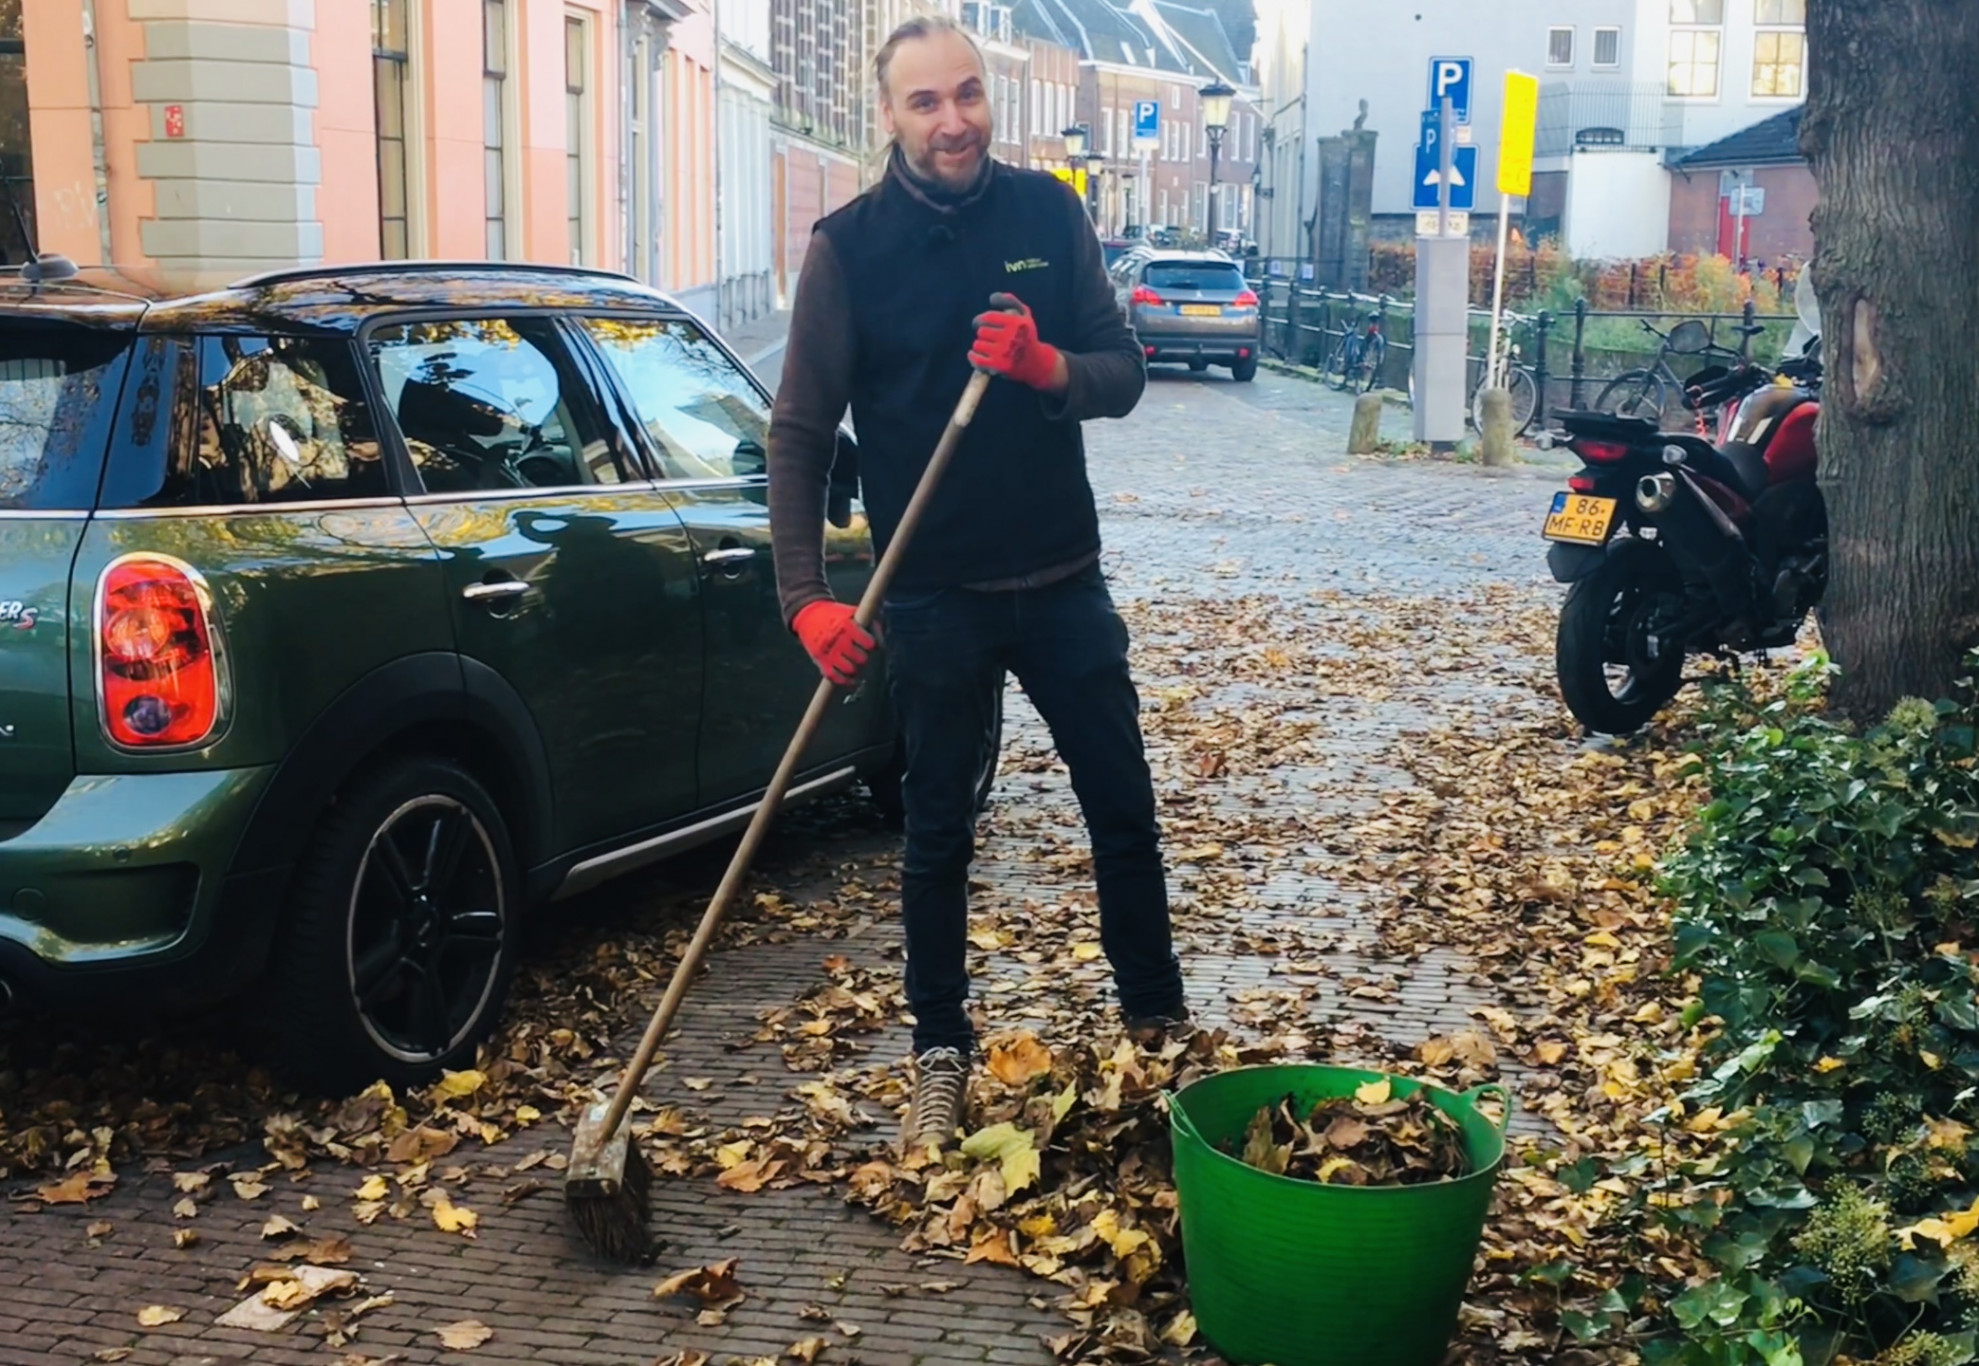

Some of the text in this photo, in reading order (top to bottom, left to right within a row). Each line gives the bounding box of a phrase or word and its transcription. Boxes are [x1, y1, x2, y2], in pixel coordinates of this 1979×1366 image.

[1437, 62, 1463, 97] P
[1139, 103, 1155, 123] P
[1425, 128, 1437, 154] P
